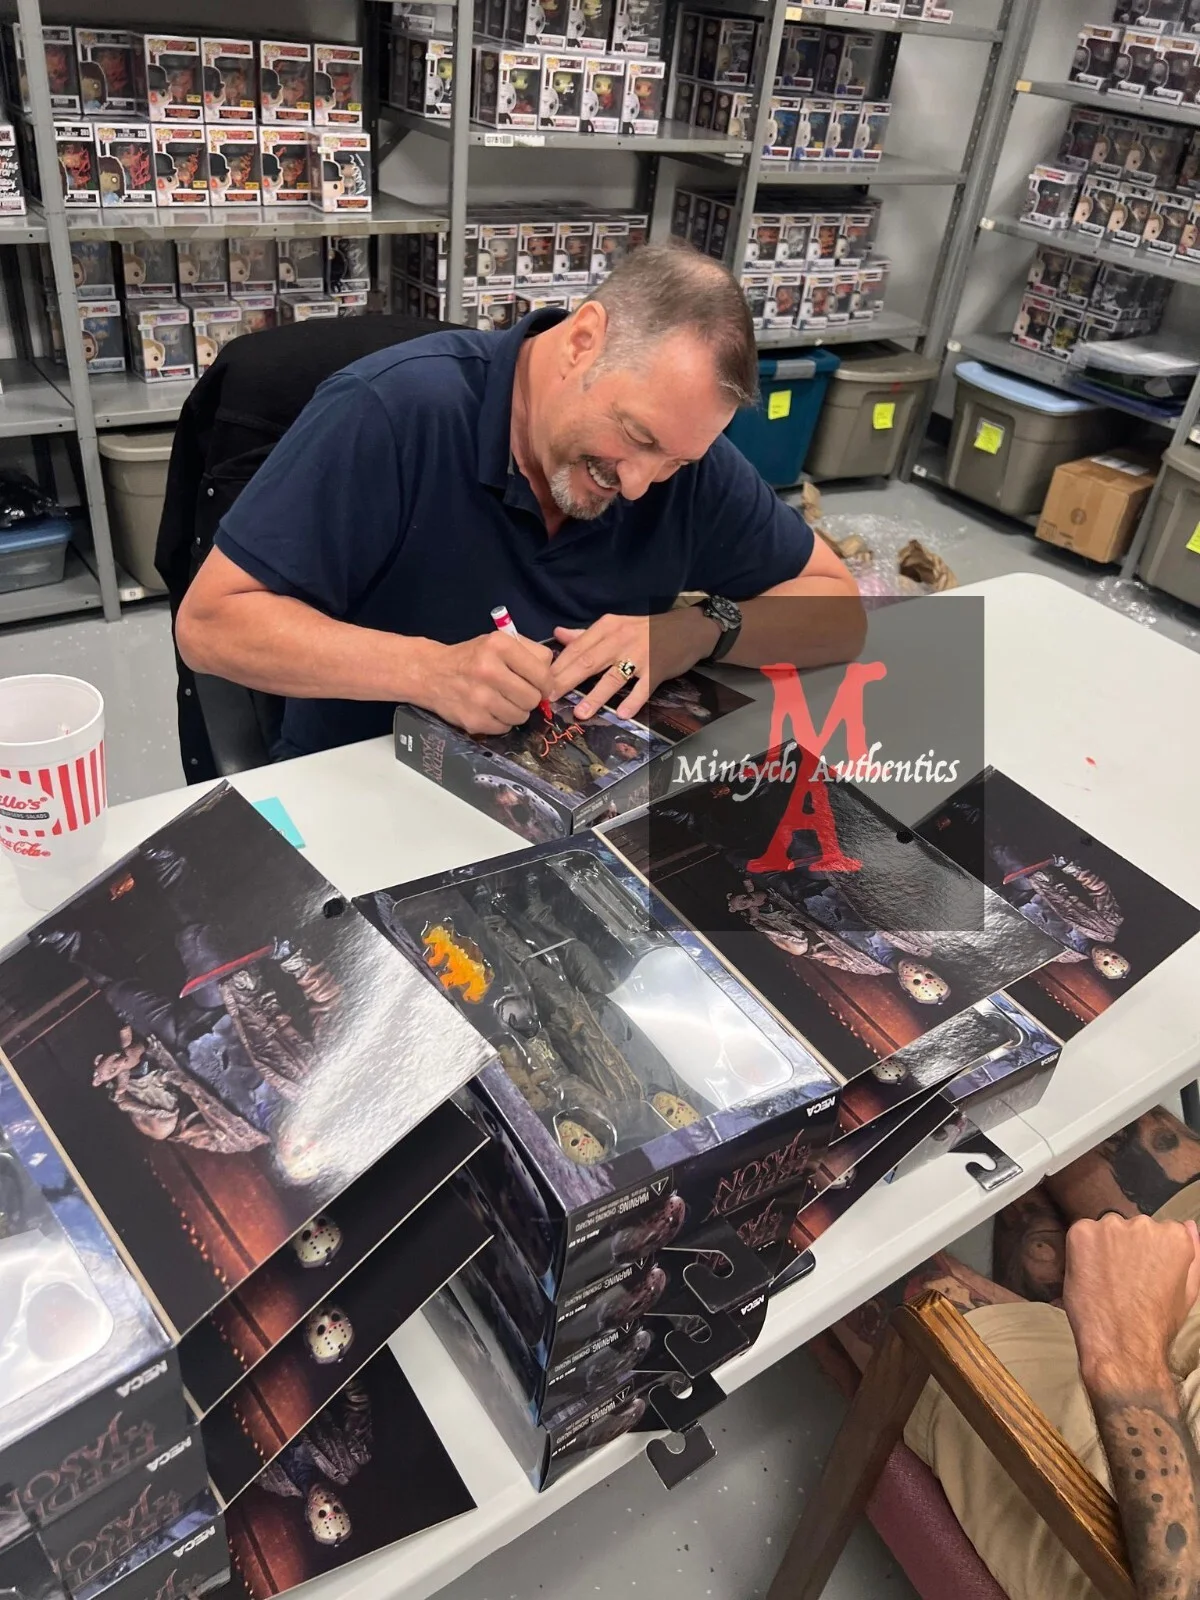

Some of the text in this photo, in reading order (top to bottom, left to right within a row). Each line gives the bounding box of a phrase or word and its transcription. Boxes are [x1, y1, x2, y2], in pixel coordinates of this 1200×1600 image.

[806, 1095, 836, 1117] NECA
[741, 1294, 764, 1315] NECA
[116, 1360, 168, 1398] NECA
[146, 1435, 193, 1472] NECA
[172, 1525, 216, 1558] NECA
